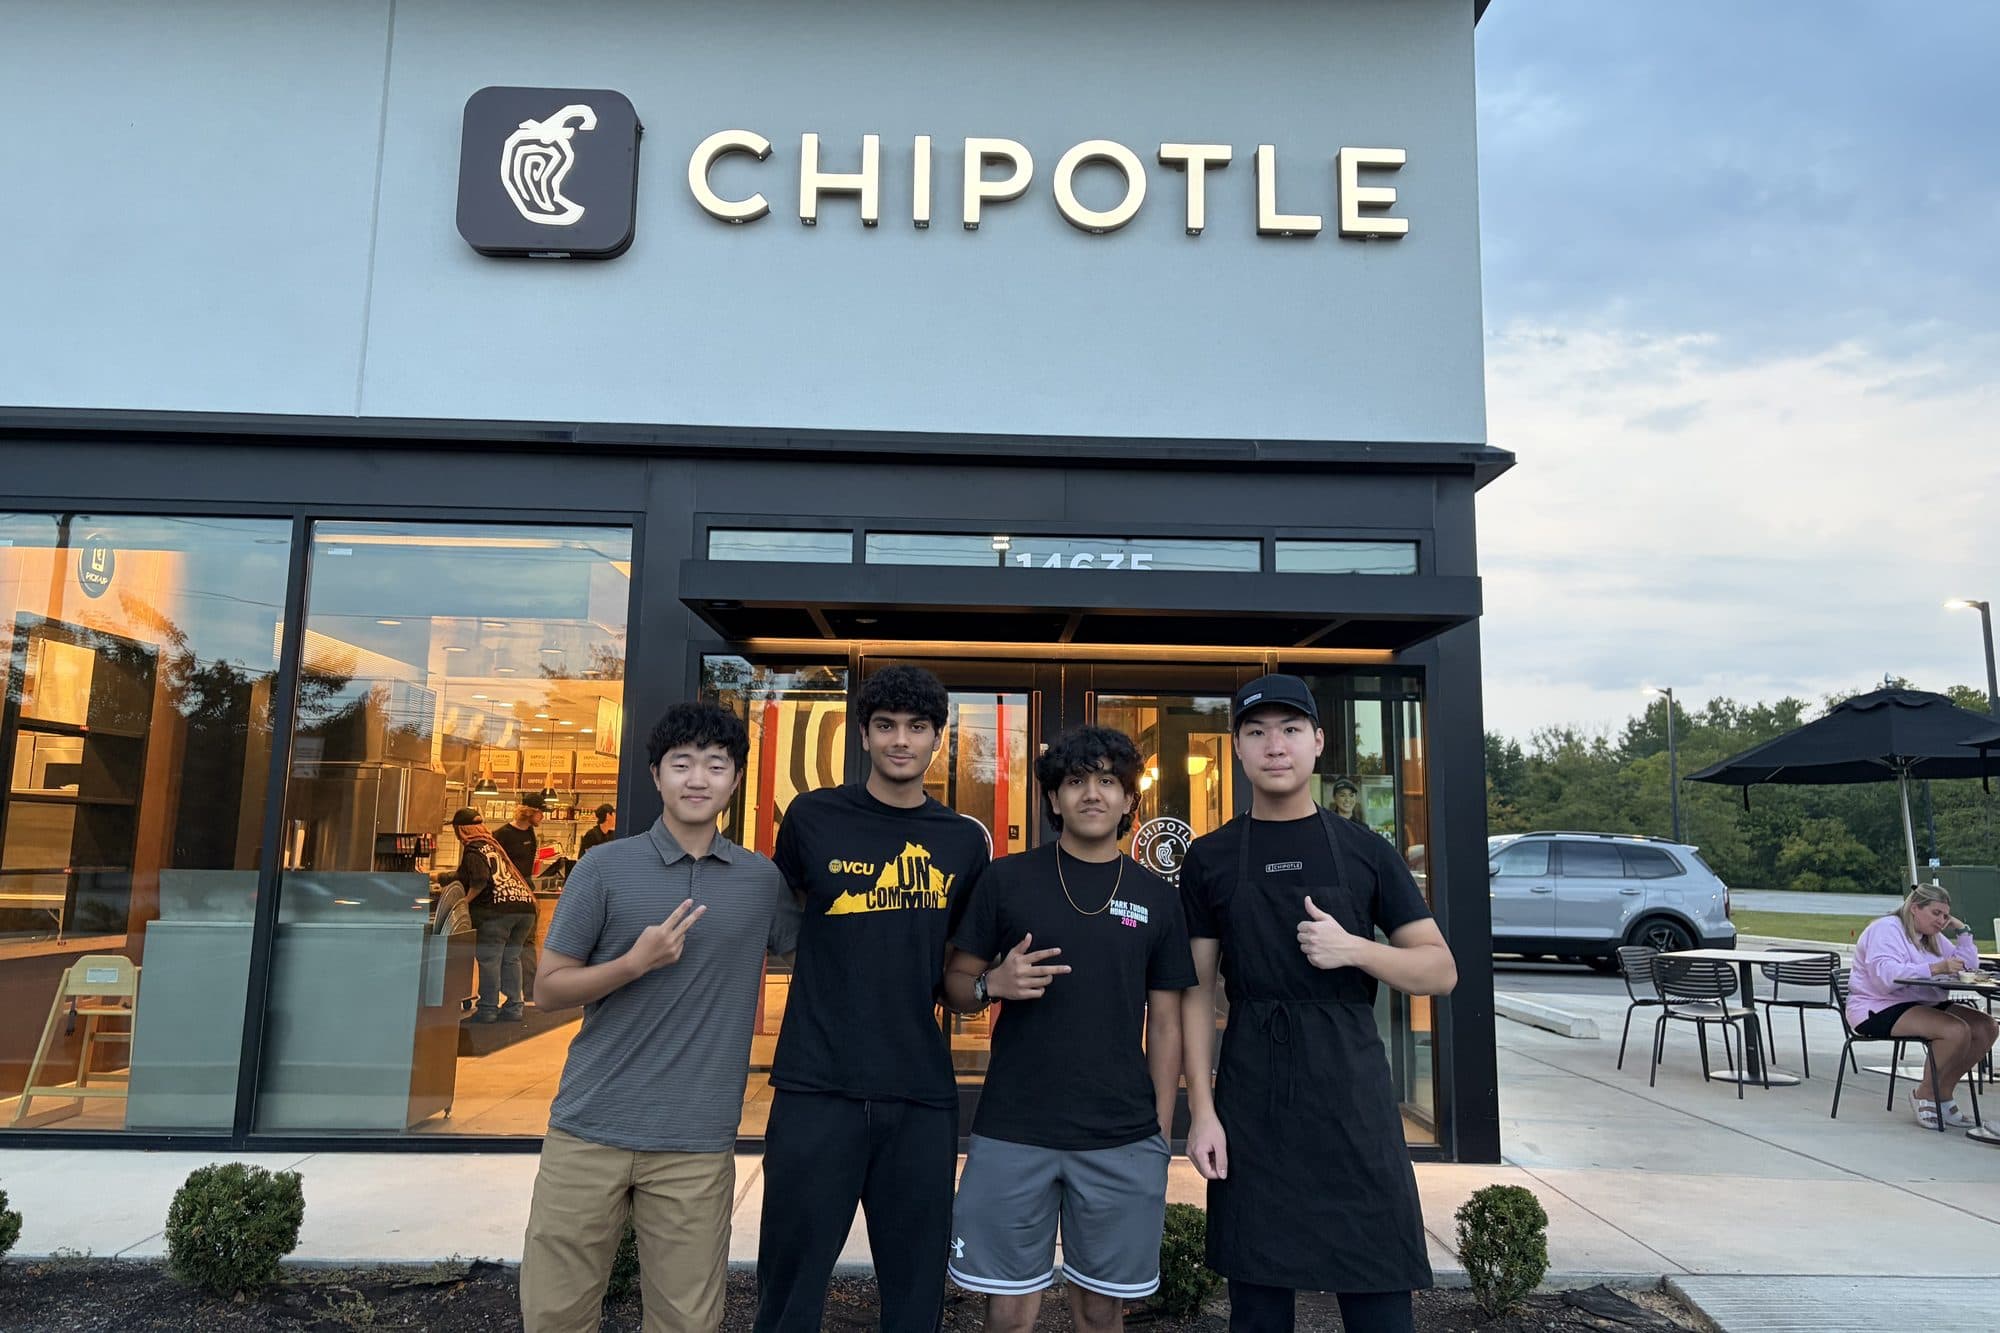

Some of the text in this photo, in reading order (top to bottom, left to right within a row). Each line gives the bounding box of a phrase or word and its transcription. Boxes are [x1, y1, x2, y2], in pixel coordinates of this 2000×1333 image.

[688, 129, 1409, 237] CHIPOTLE
[842, 861, 875, 875] VCU
[897, 856, 930, 890] UN
[866, 886, 939, 909] COMMON
[1110, 899, 1128, 911] PARK
[1110, 907, 1149, 924] HOMECOMING
